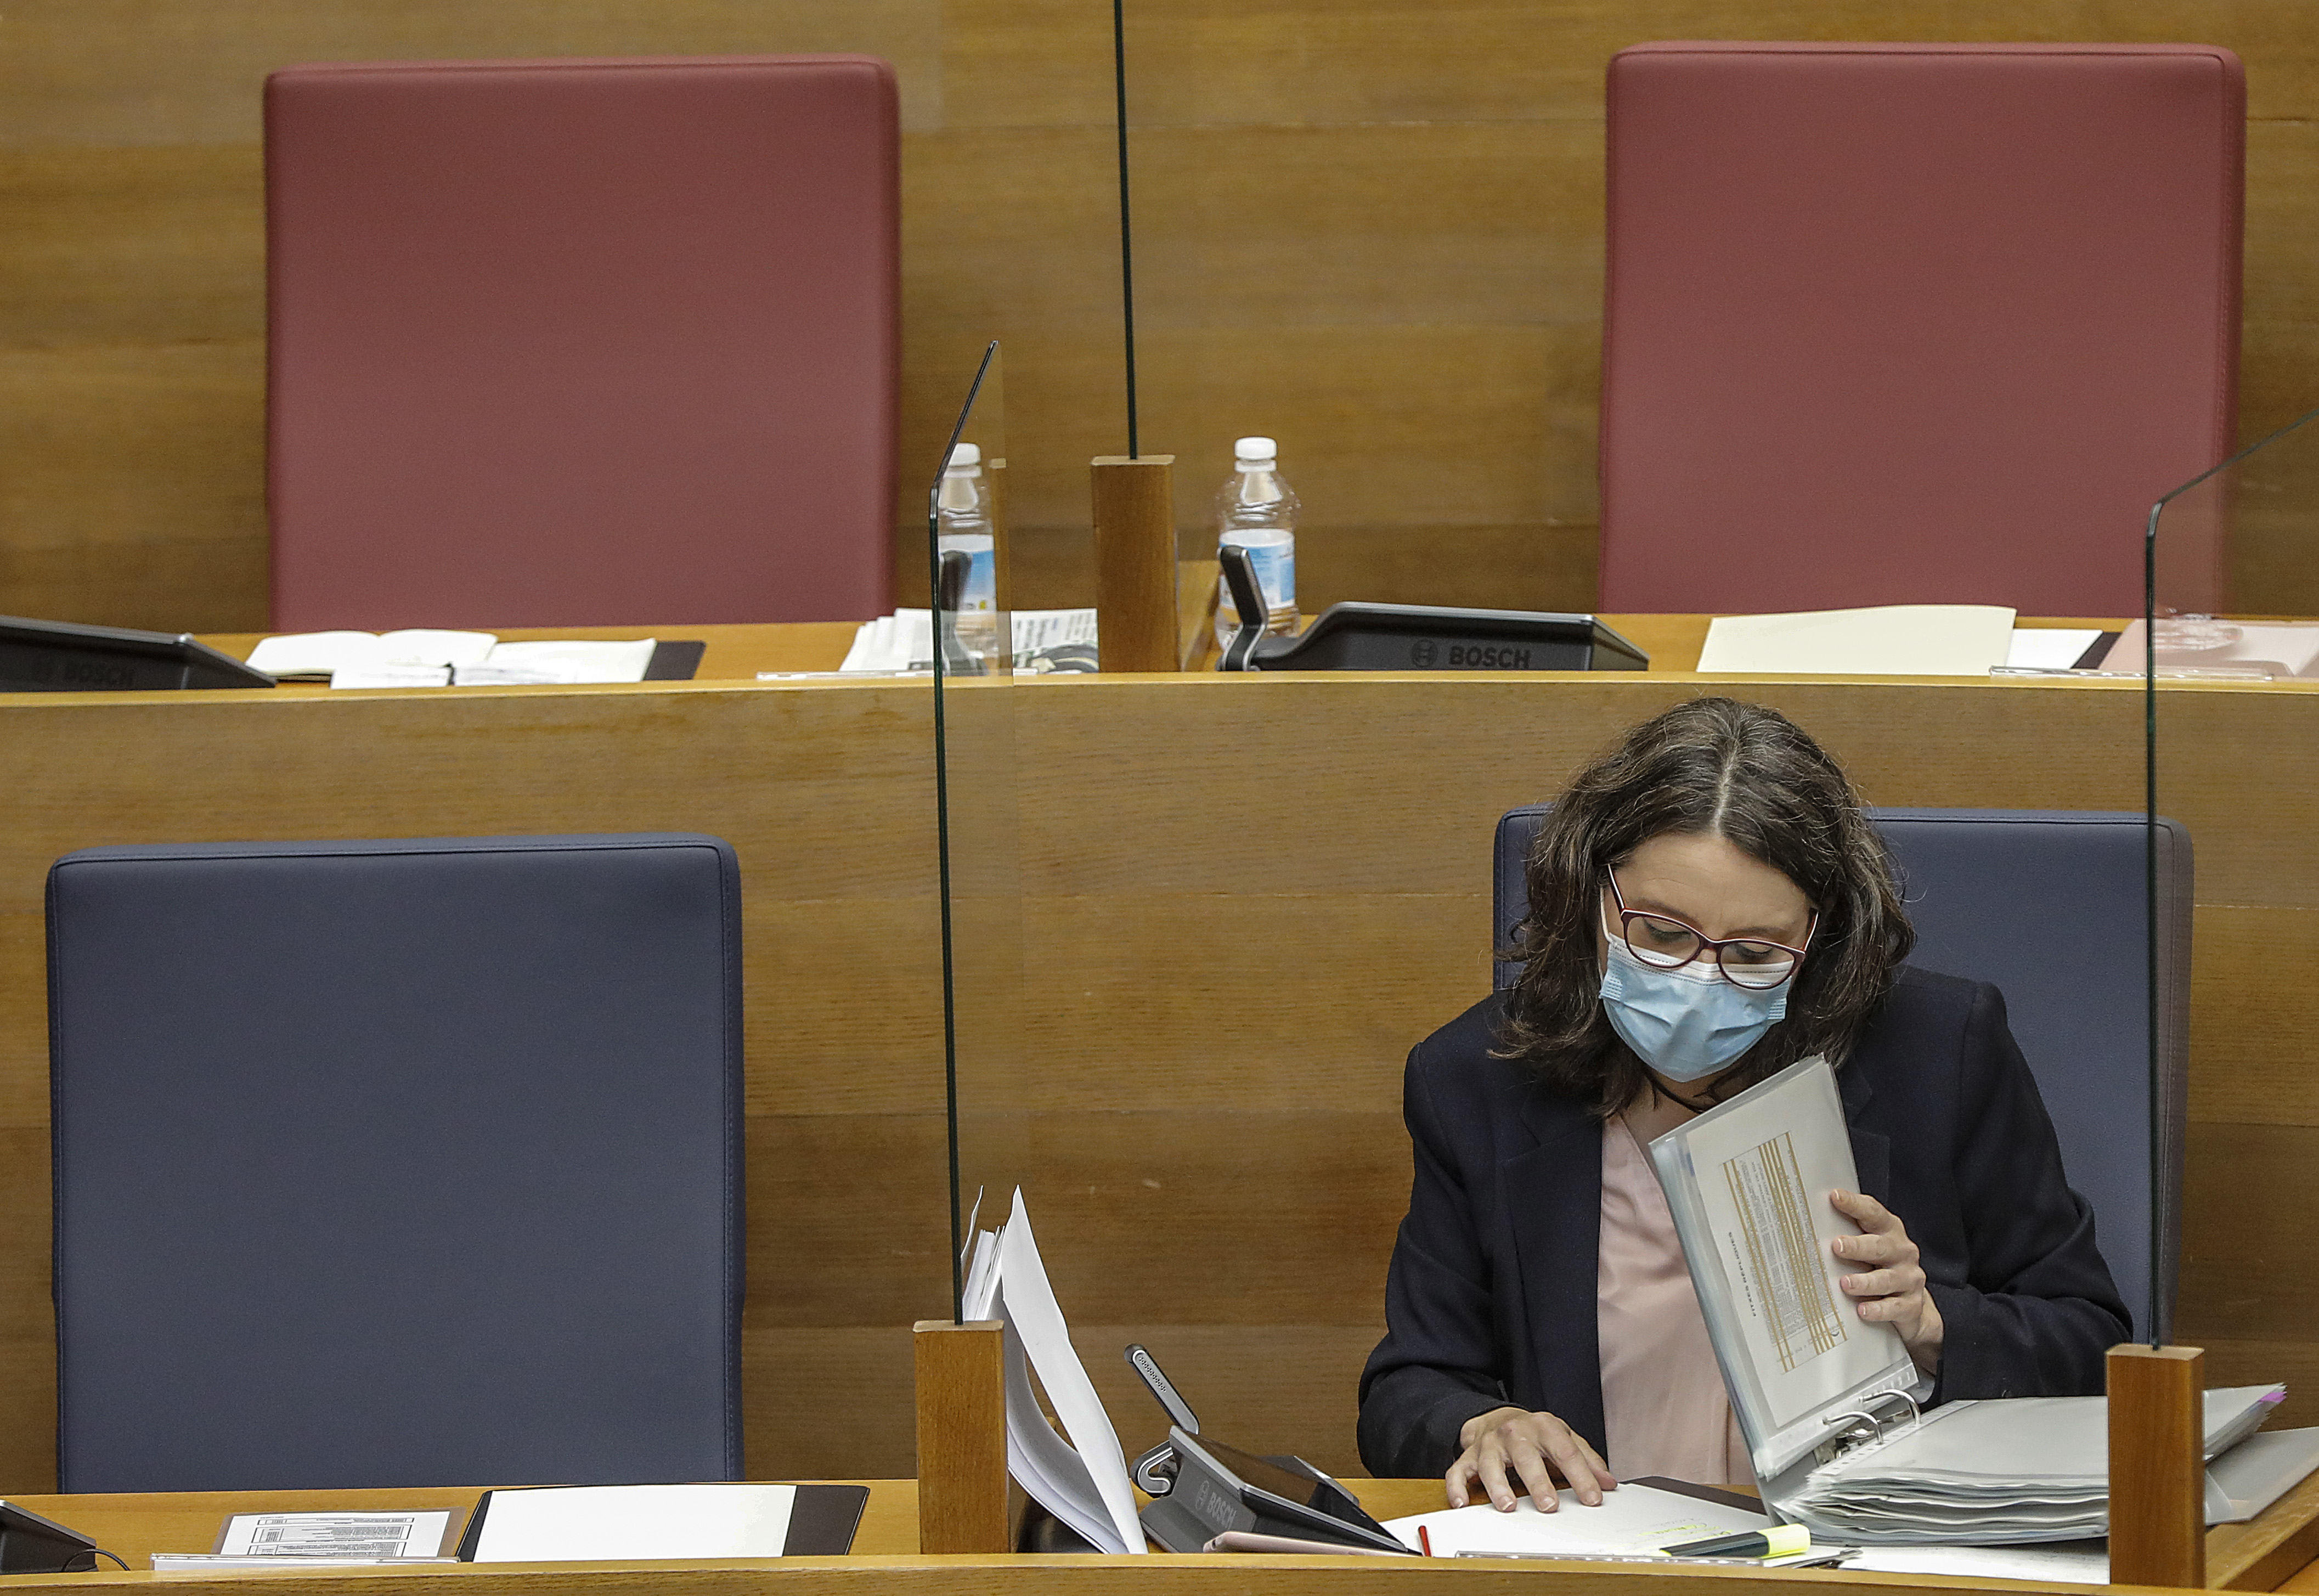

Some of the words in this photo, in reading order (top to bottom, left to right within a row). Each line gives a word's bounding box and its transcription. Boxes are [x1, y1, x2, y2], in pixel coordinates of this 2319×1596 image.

[1448, 645, 1532, 669] BOSCH
[1745, 1285, 1756, 1317] FITXES
[1207, 1491, 1237, 1530] BOSCH
